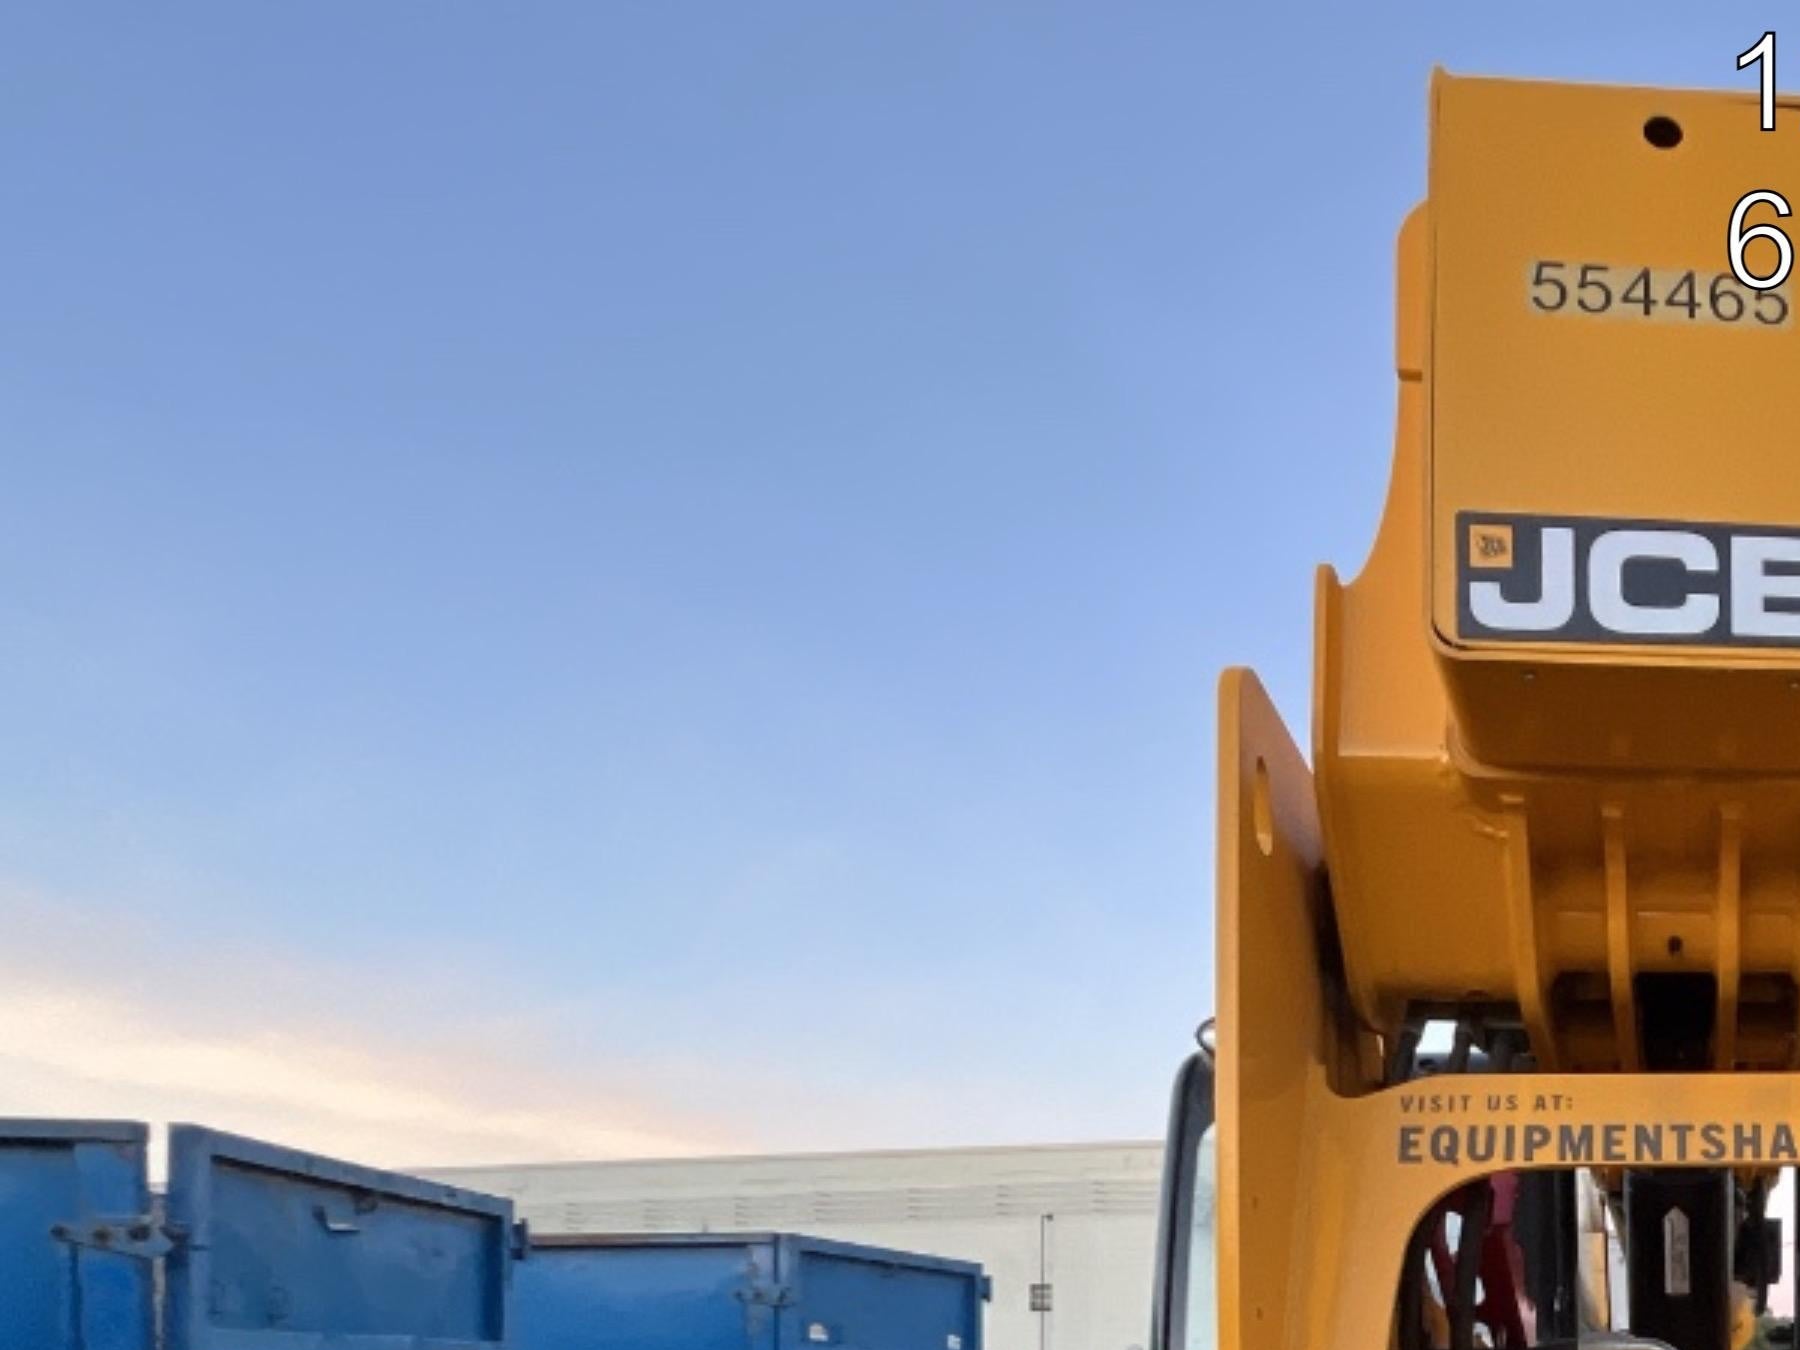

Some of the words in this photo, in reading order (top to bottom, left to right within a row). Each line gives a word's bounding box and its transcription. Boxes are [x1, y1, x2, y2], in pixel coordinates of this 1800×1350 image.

[1530, 260, 1790, 325] 554465
[1400, 1093, 1473, 1114] VISIT
[1487, 1093, 1519, 1113] US
[1533, 1092, 1574, 1112] AT:
